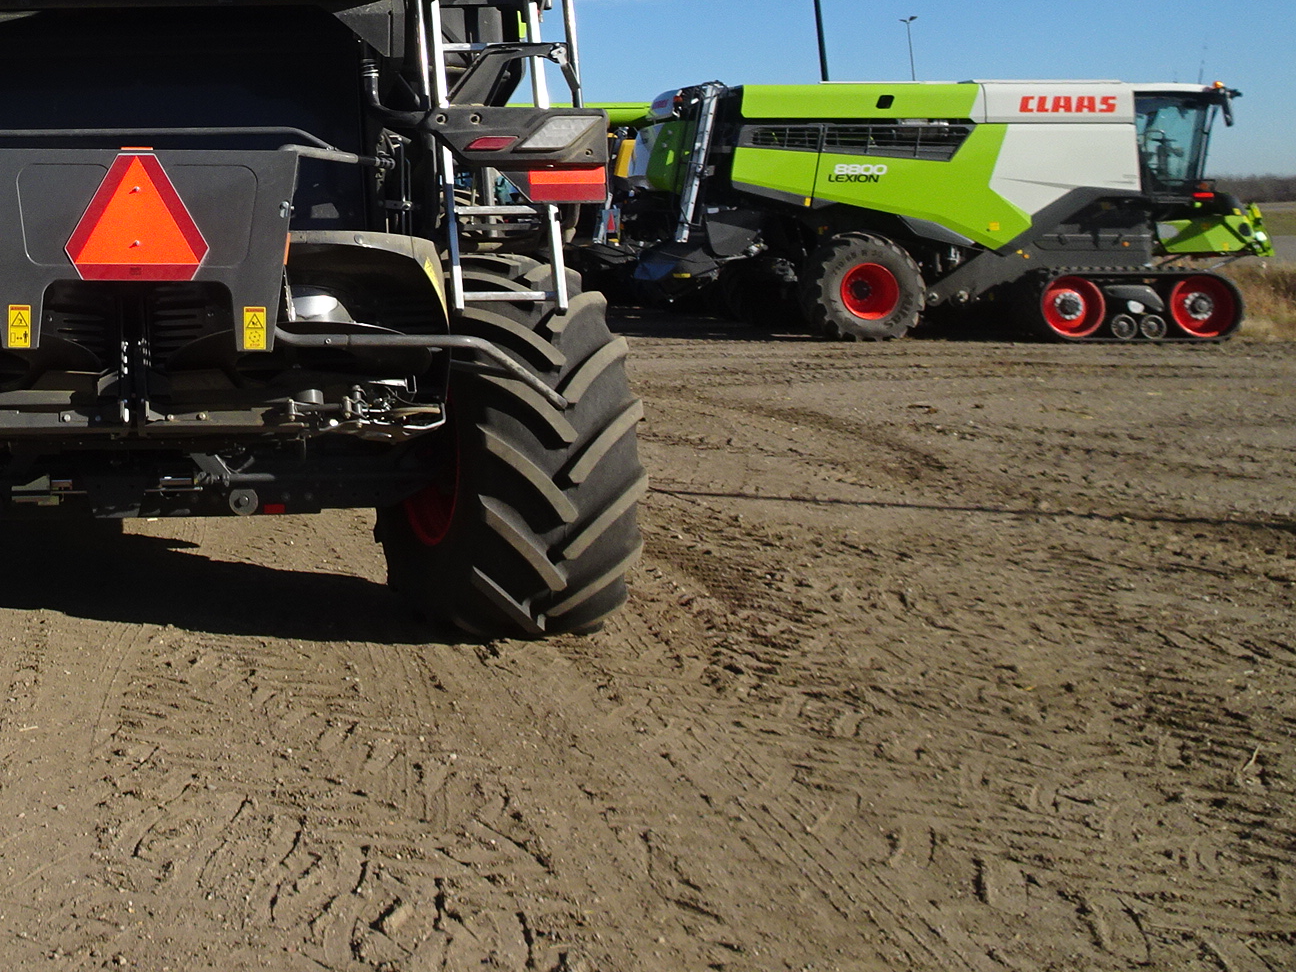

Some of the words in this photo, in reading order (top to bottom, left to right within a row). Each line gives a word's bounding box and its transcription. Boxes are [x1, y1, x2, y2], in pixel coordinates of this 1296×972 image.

[1019, 95, 1117, 113] CLAAS
[834, 163, 888, 175] 8800
[827, 174, 880, 183] LEXION
